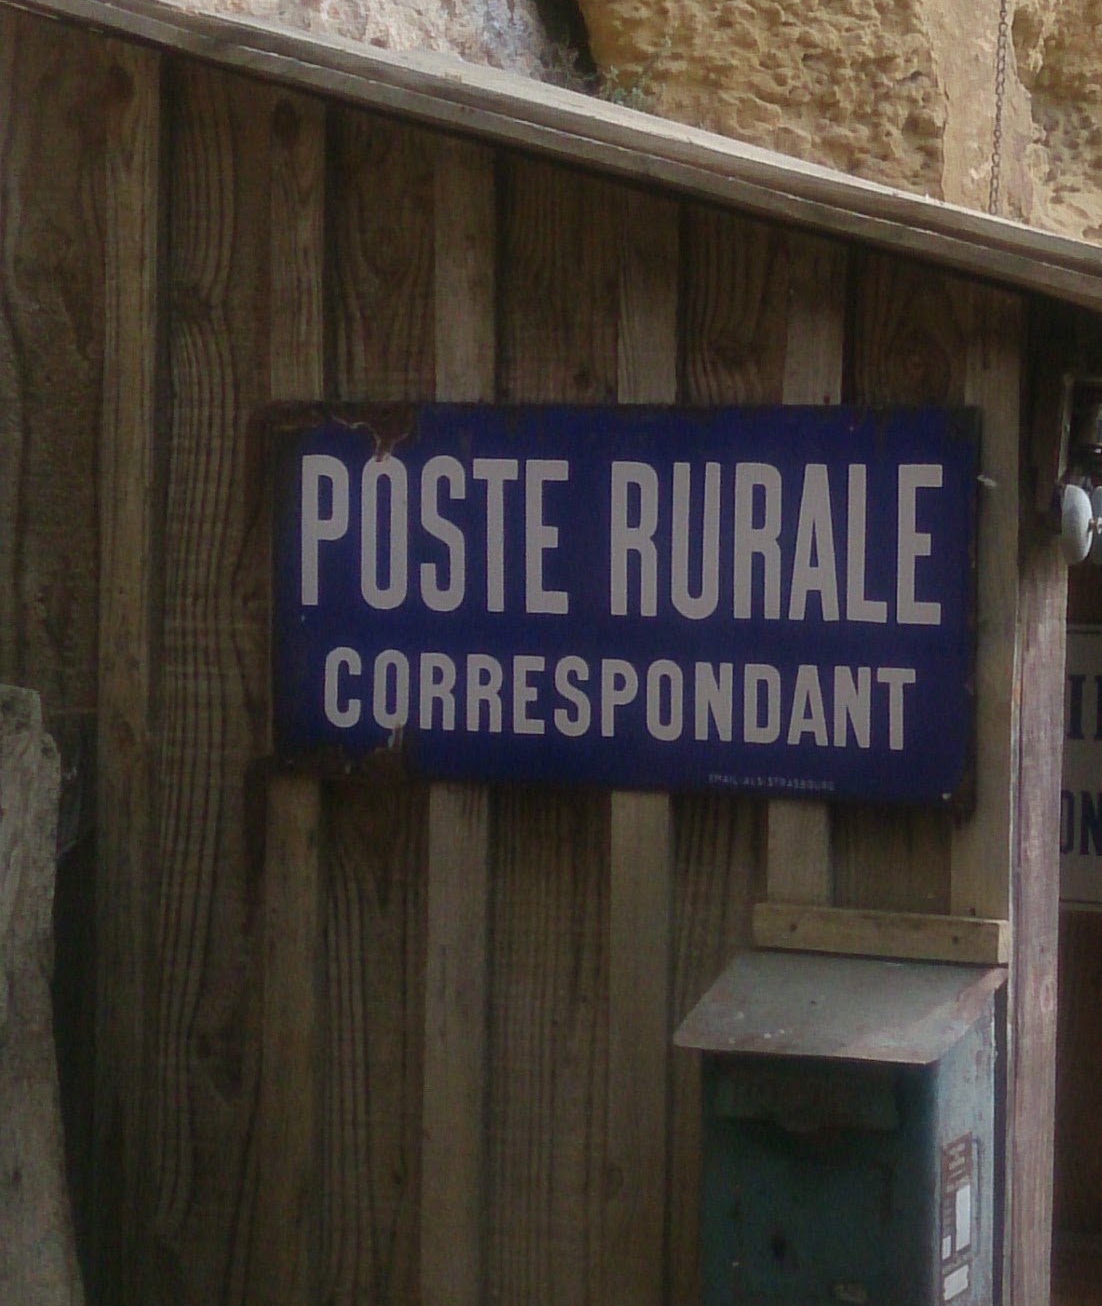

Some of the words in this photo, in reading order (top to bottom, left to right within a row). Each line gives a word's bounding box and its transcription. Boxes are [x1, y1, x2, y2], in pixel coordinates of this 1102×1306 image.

[301, 451, 570, 615] POSTE
[610, 459, 944, 626] RURALE
[323, 646, 917, 751] CORRESPONDANT
